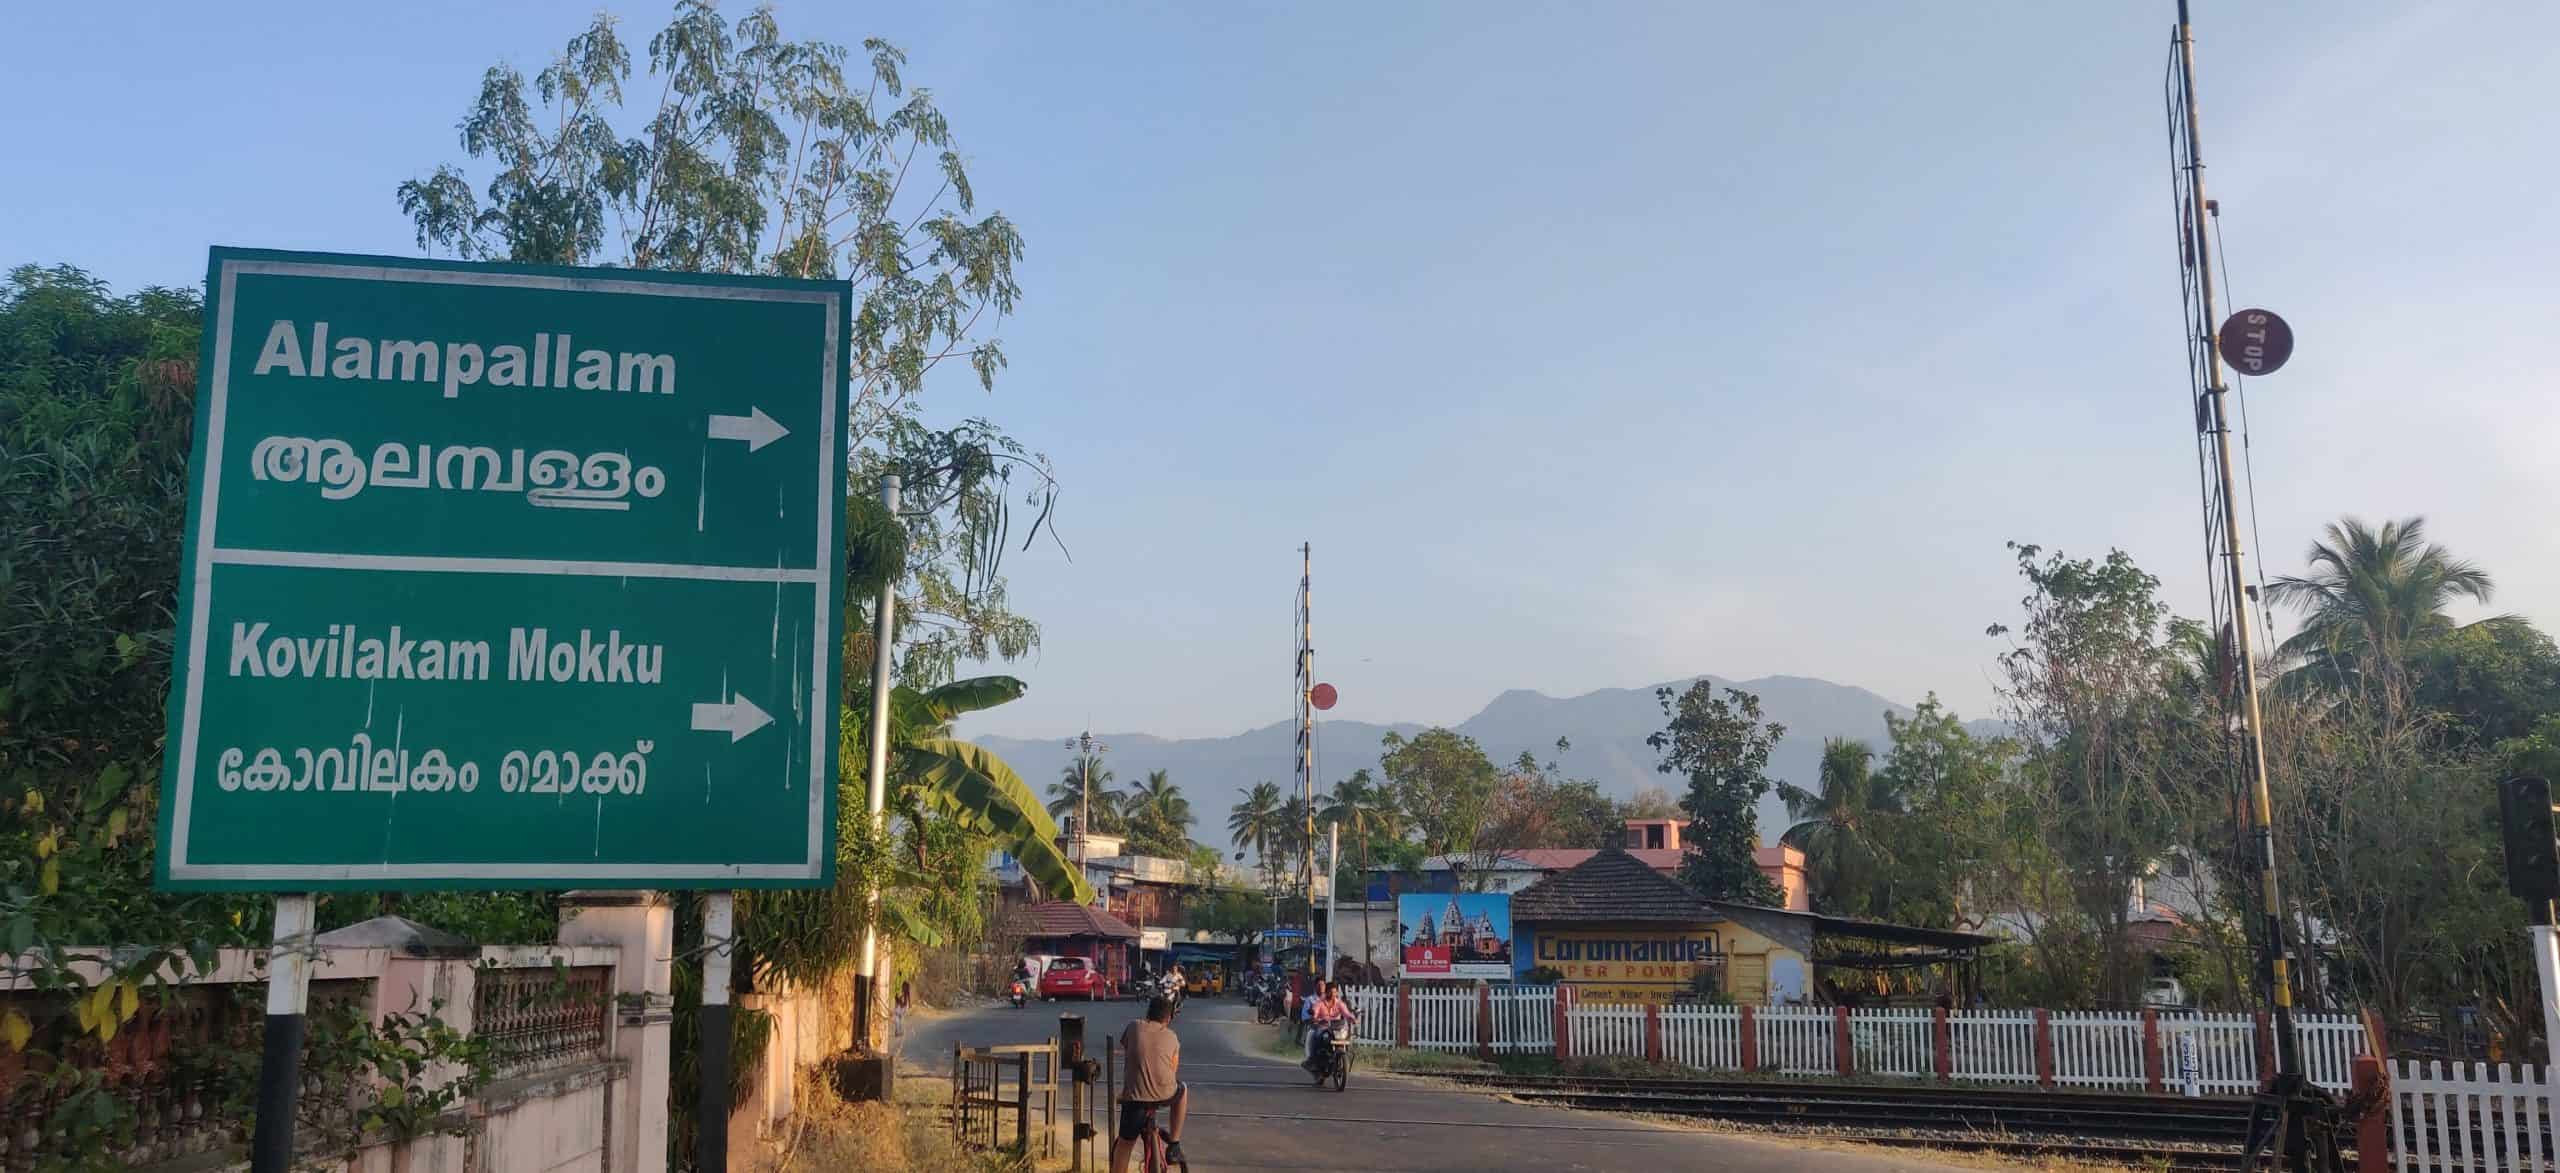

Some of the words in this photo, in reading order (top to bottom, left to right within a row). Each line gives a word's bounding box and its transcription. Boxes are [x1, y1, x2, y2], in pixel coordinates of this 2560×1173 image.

[253, 320, 676, 398] Alampallam
[2242, 313, 2267, 371] STOP
[251, 435, 666, 511] ആലമ്പള്ളം
[229, 621, 490, 681] Kovilakam
[507, 626, 663, 684] Mokku
[217, 732, 480, 792] കോവിലകം
[499, 739, 655, 795] മൊക്ക്
[1538, 936, 1712, 961] Coromandel
